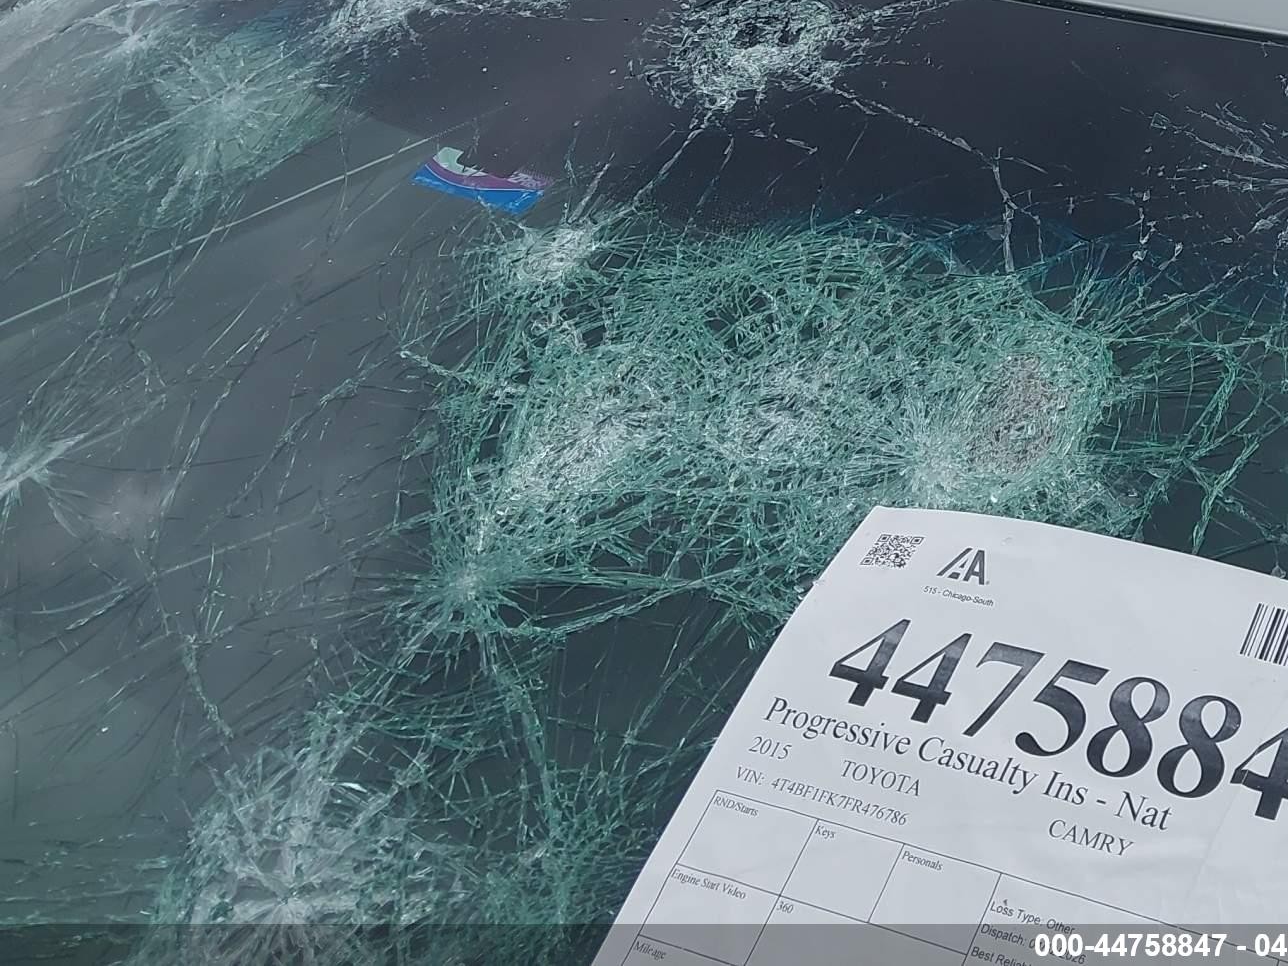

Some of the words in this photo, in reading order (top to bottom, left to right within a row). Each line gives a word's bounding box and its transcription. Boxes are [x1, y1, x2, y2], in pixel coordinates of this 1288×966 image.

[923, 585, 938, 595] 515
[942, 589, 995, 607] Chicago-South
[763, 696, 911, 755] Progressive
[918, 736, 1039, 795] Casualty
[1043, 770, 1089, 806] Ins
[1114, 790, 1172, 831] Nat
[713, 795, 759, 817] RND/Starts
[736, 766, 766, 786] VIN:
[771, 777, 910, 826] 4T4BF1FK7FR476786
[748, 736, 792, 760] 2015
[840, 759, 921, 797] TOYOTA
[1048, 819, 1134, 856] CAMRY
[815, 825, 836, 839] Keys
[901, 850, 944, 871] Personals
[671, 868, 701, 886] Engine
[703, 878, 720, 891] Start
[721, 883, 747, 900] Video
[776, 901, 794, 914] 360
[990, 901, 1014, 917] Loss
[1046, 918, 1076, 935] Other
[980, 923, 1025, 947] Dispatch:
[634, 941, 667, 961] Mileage
[971, 946, 994, 962] Best
